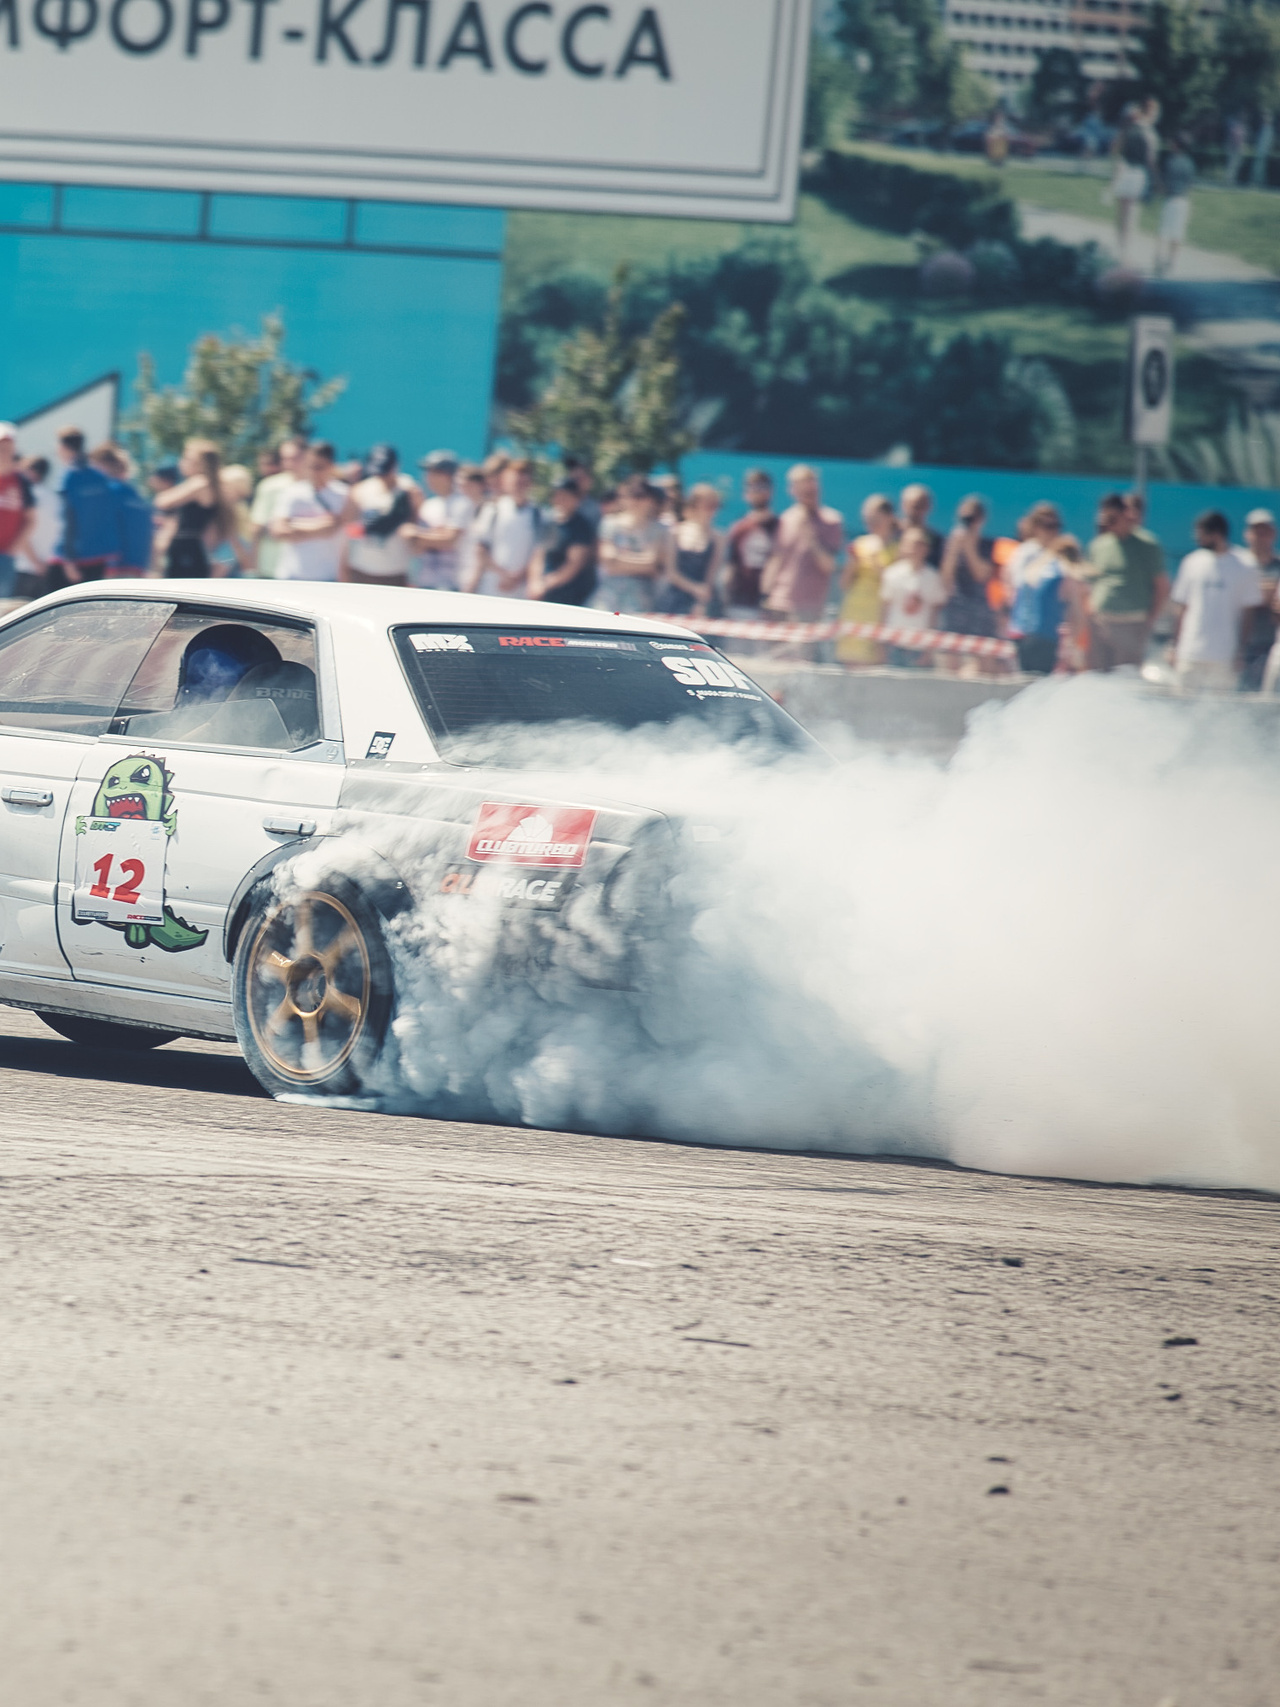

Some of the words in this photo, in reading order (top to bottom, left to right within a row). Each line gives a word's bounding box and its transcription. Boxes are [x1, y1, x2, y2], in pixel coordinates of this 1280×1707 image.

[498, 636, 567, 648] RACE
[661, 656, 751, 690] SDF
[255, 687, 315, 700] BRIDE
[476, 840, 579, 855] CLUBTURBO
[90, 853, 145, 904] 12
